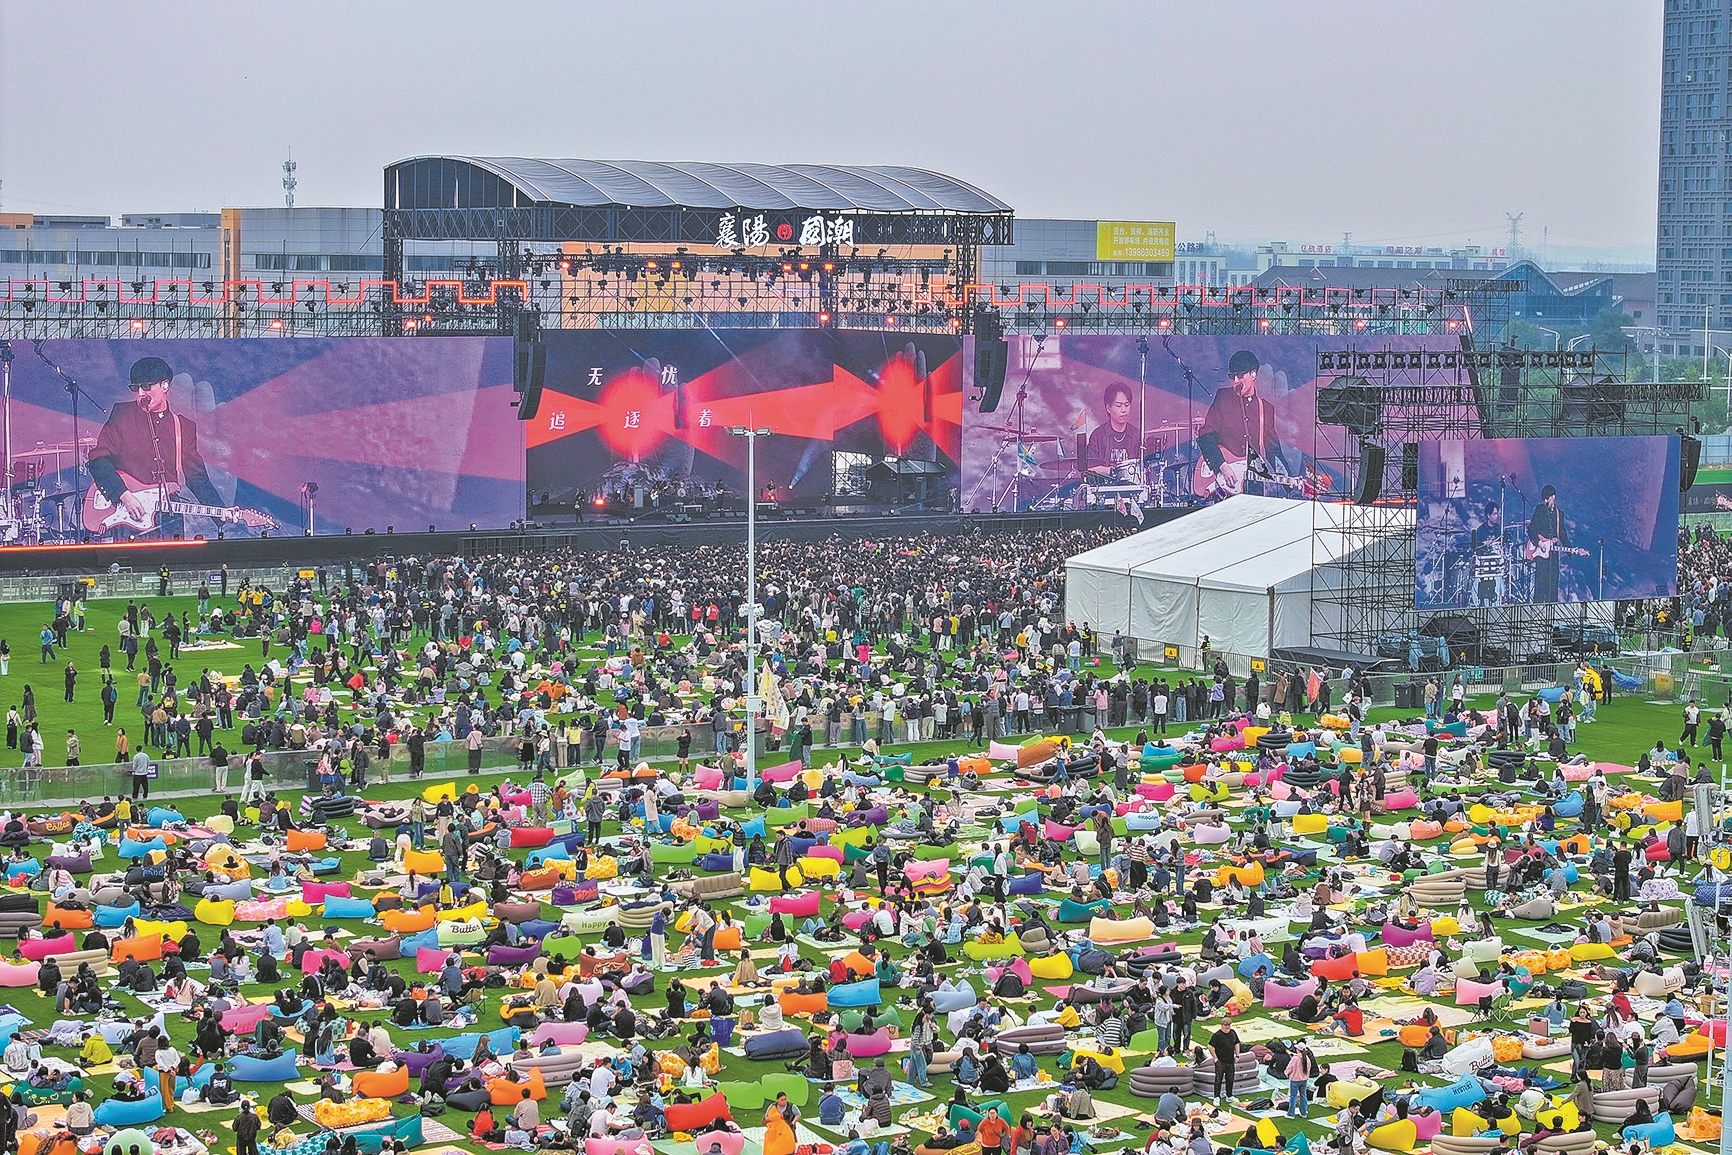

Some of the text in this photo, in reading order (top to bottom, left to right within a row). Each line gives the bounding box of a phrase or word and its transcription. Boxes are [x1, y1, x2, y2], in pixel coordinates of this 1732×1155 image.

[44, 820, 70, 832] Coffee
[450, 924, 480, 934] Butter
[1468, 1054, 1493, 1071] Butter
